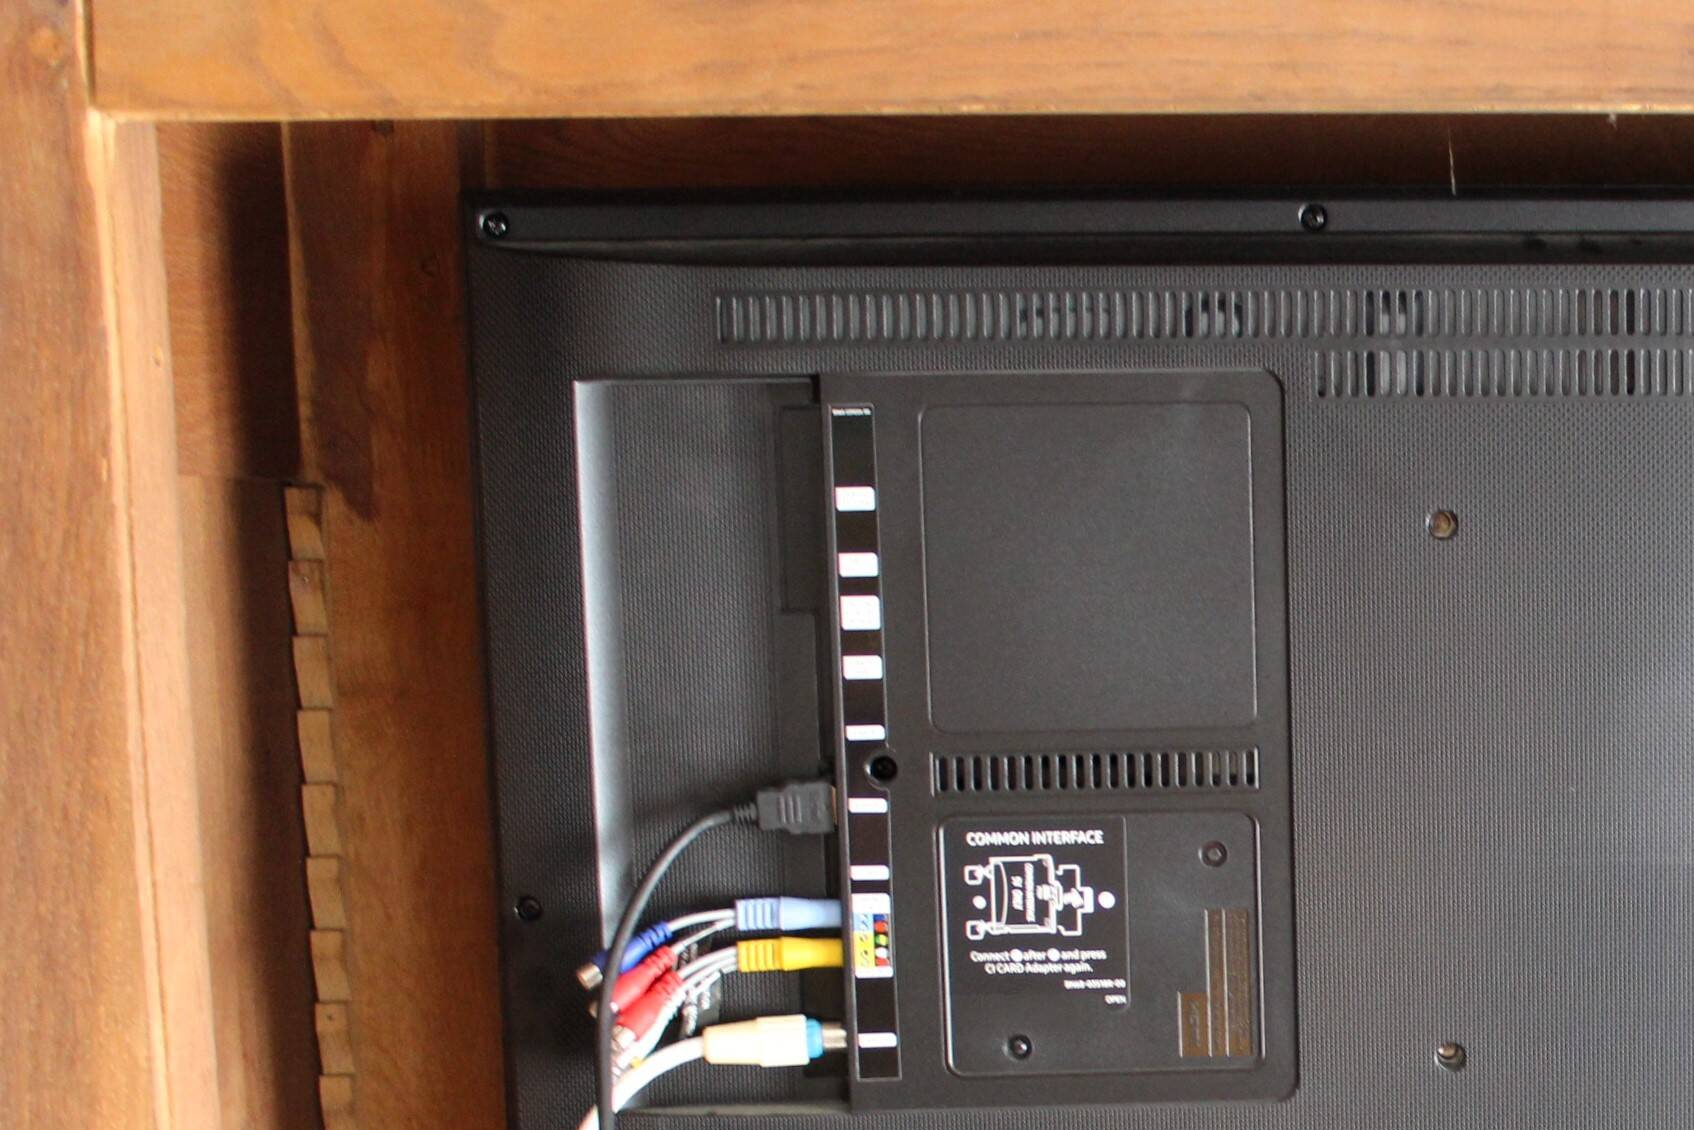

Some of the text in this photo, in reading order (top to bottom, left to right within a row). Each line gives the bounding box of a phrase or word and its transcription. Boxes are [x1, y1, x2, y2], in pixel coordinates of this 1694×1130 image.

[966, 830, 1104, 846] COMMON INTERFACE
[970, 951, 1010, 962] Connect
[1023, 949, 1046, 961] after
[1061, 949, 1079, 960] and
[1080, 950, 1107, 961] press
[996, 962, 1024, 974] CARD
[1025, 962, 1062, 975] Adapter
